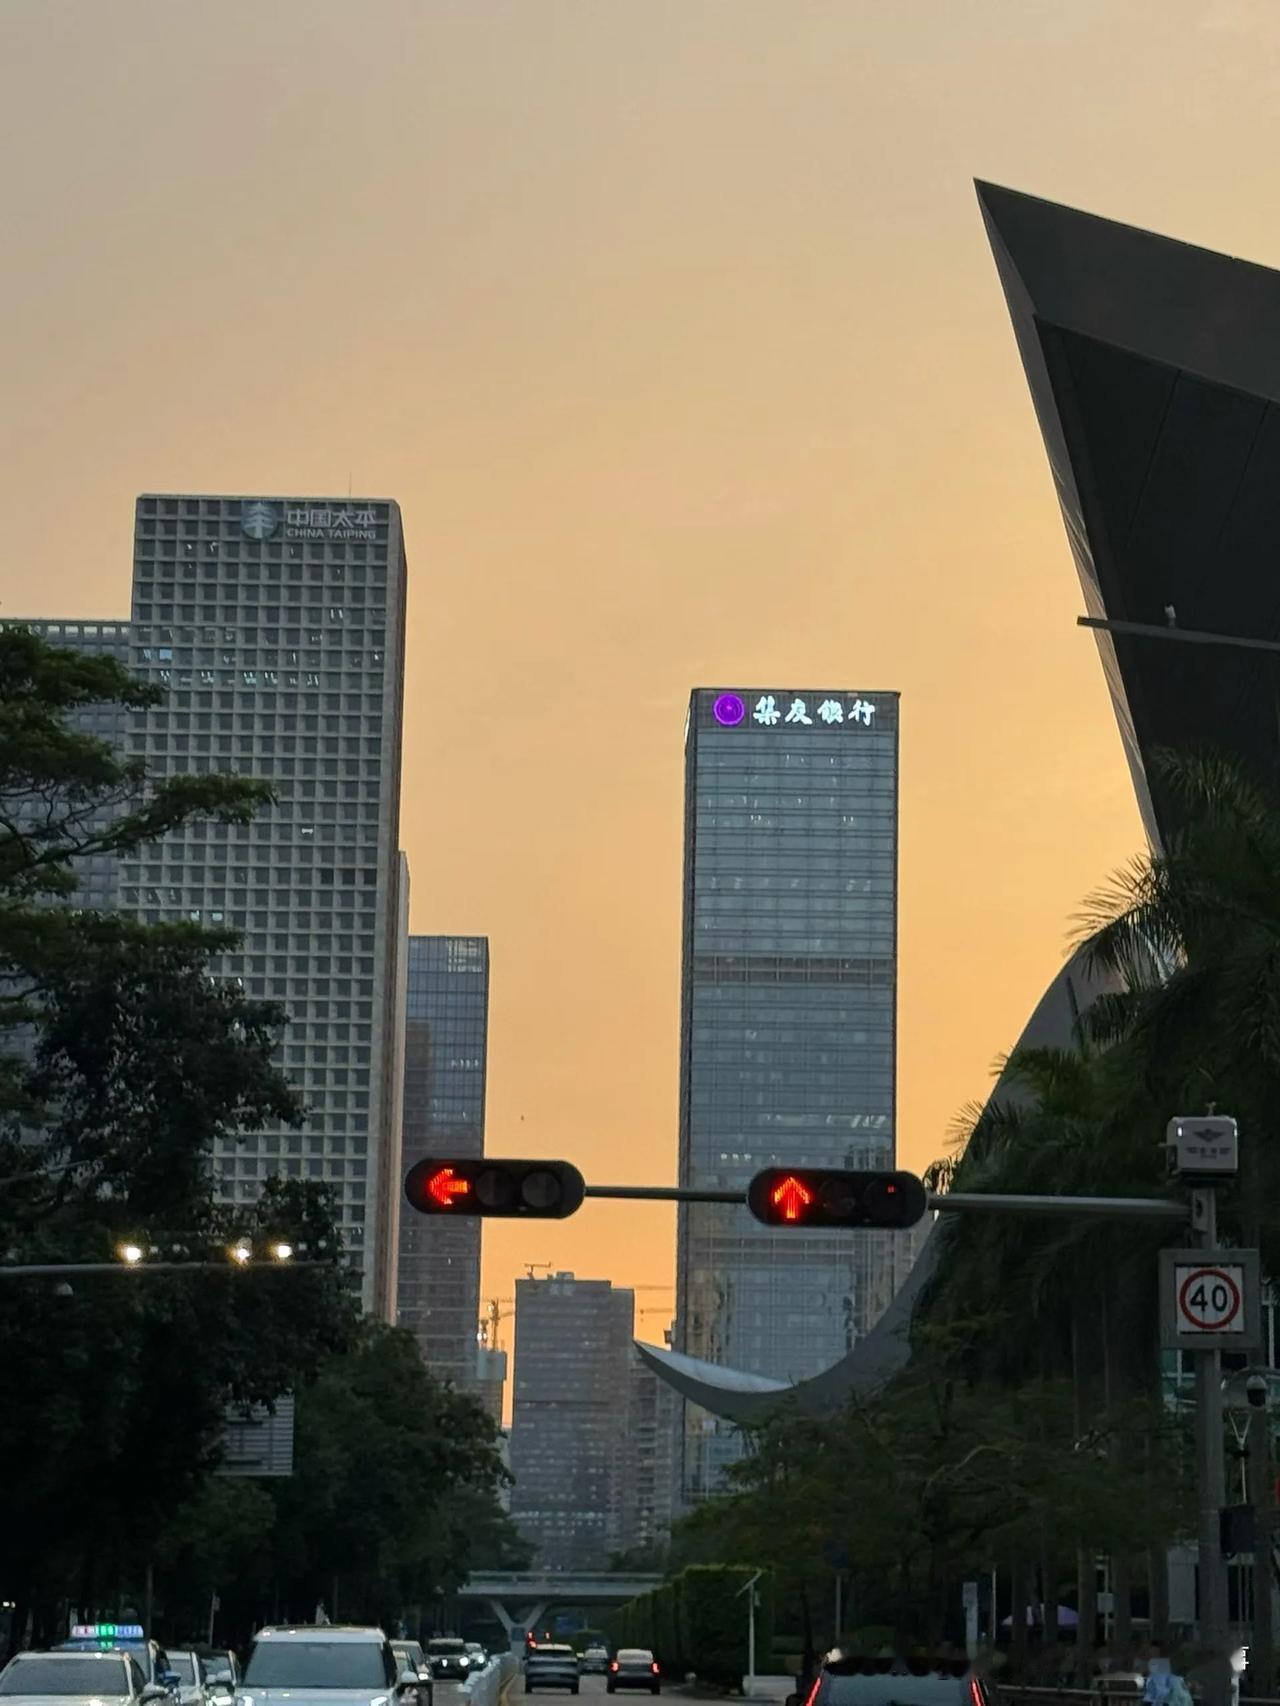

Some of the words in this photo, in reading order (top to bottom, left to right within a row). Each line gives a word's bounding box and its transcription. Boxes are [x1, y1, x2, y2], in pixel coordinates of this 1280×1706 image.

[287, 508, 376, 528] 中国太平
[287, 528, 325, 538] CHINA
[328, 528, 376, 539] TAIPING
[1190, 1284, 1227, 1312] 40
